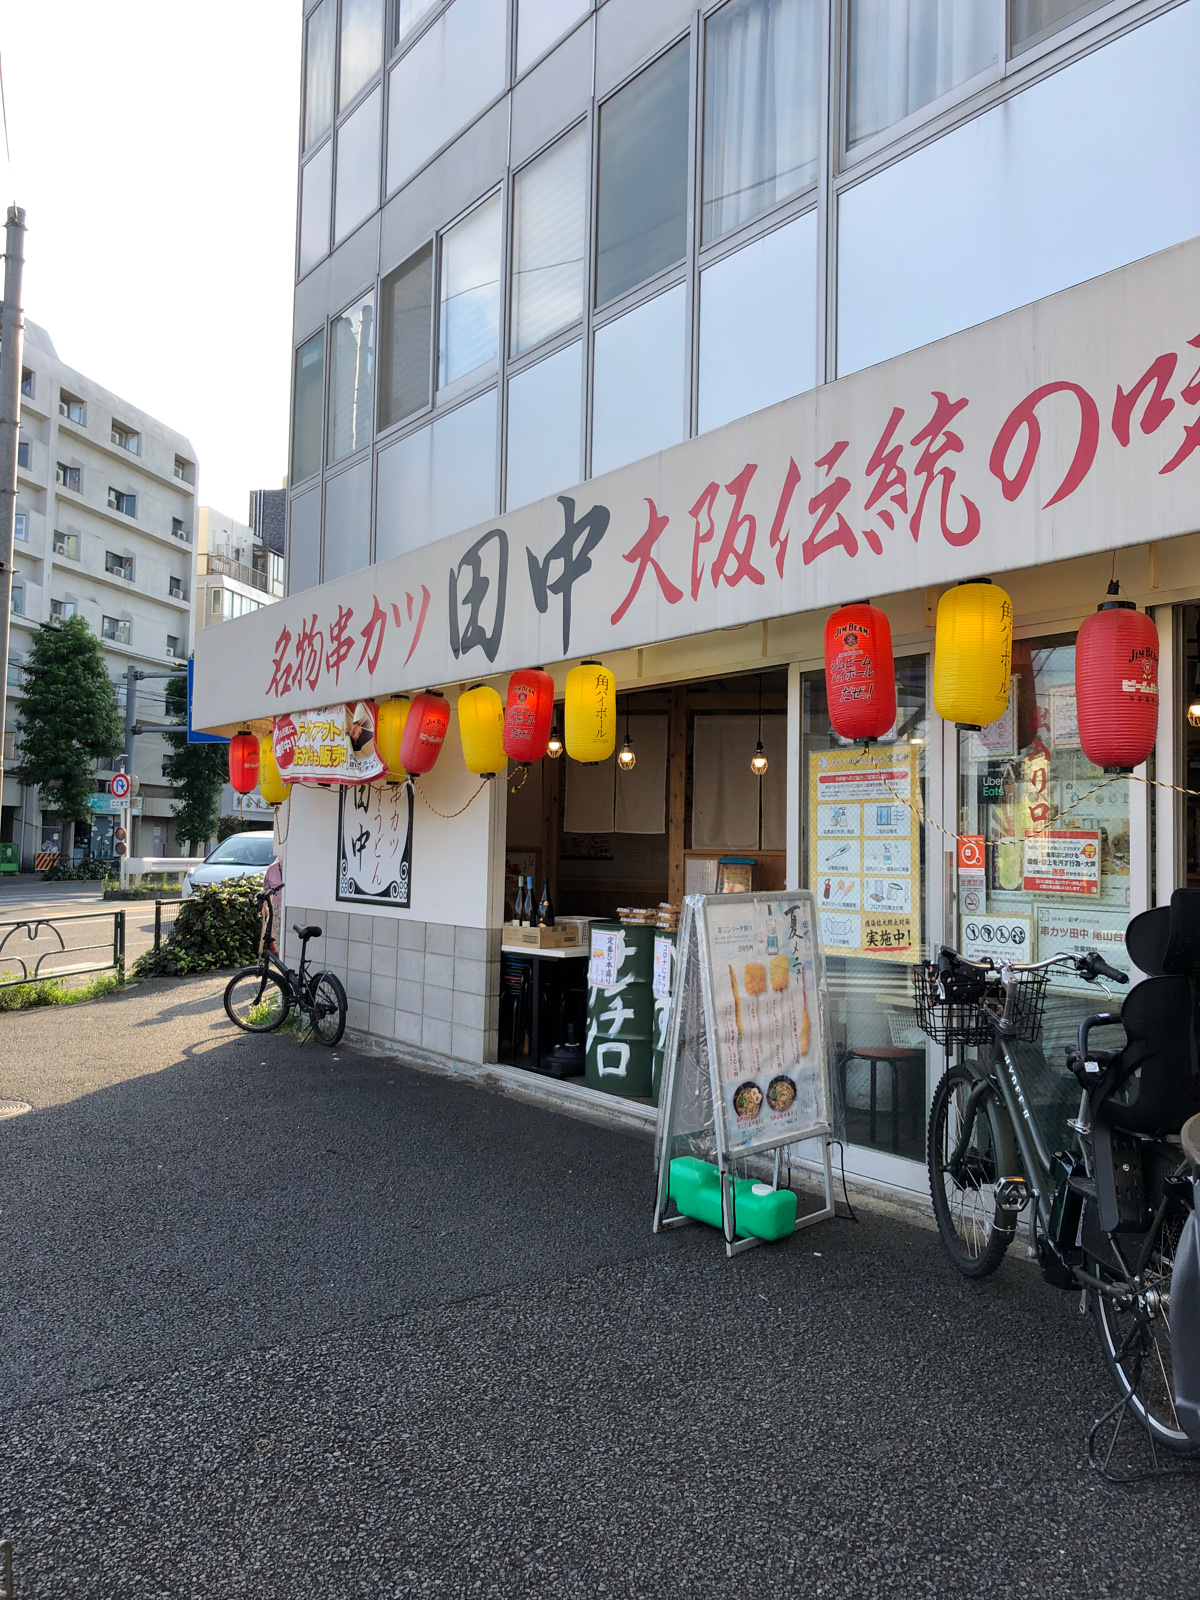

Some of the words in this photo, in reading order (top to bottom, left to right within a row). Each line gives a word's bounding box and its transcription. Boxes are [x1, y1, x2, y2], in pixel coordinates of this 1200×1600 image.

[265, 584, 431, 698] 名物串カツ
[449, 495, 611, 664] 田中
[834, 625, 848, 639] JIM
[848, 622, 869, 638] BEAM
[997, 600, 1013, 695] 角ハイボール
[1128, 649, 1145, 663] JIM
[830, 654, 872, 674] ジムビーム
[830, 667, 874, 685] ハイボール
[594, 673, 609, 738] 角ハイボール
[1028, 705, 1052, 823] 出入り口
[983, 777, 1005, 786] Uber
[983, 787, 1005, 796] Eats
[865, 918, 911, 927] 感染拡大防止対策
[865, 928, 912, 947] 実施中!
[1040, 926, 1089, 939] 串カツ田中
[1092, 930, 1126, 943] 尾山台
[784, 904, 804, 986] 夏メニュー
[605, 935, 616, 985] 定番5本盛り
